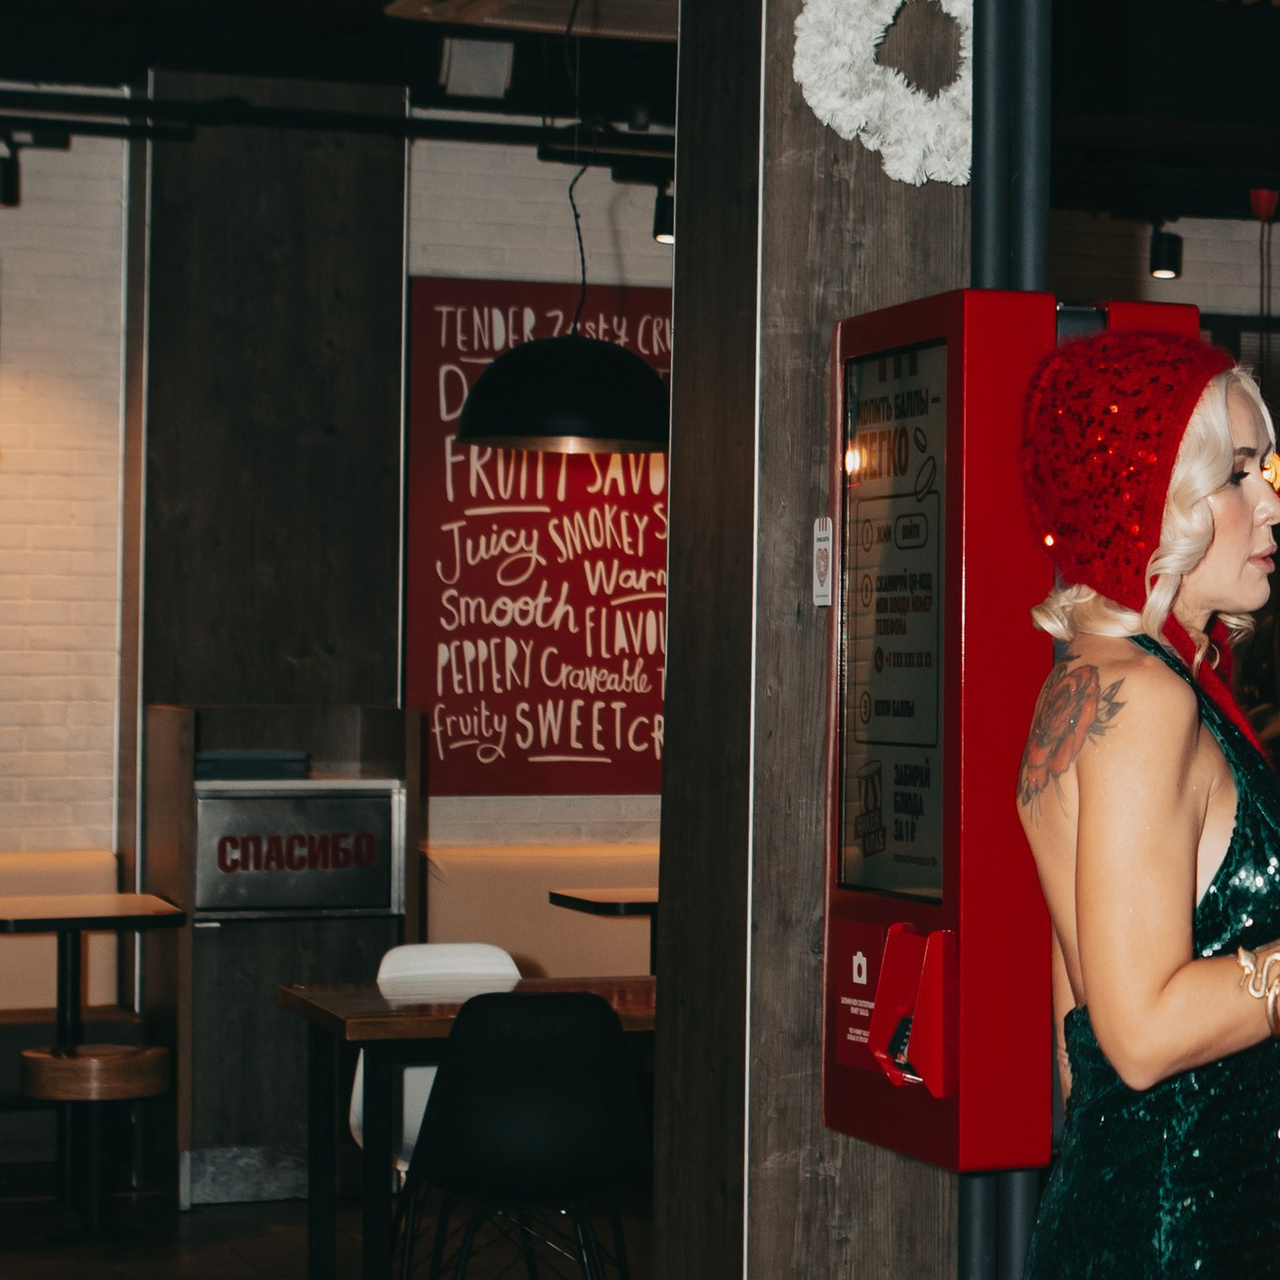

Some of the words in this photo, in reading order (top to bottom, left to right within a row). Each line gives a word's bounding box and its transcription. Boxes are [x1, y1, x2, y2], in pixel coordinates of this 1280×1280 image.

[433, 305, 536, 352] TENDER
[894, 388, 929, 421] БАЛЛЫ
[435, 520, 548, 586] Juicy
[548, 502, 649, 564] SMOKEY
[439, 579, 580, 634] Smooth
[436, 635, 534, 697] PEPPERY
[540, 645, 653, 695] Craveable
[430, 700, 507, 764] fruity
[515, 698, 628, 751] SWEET
[894, 757, 931, 789] ЗАБИРАЙ
[893, 791, 924, 821] БЛЮДА
[217, 831, 377, 874] СПАСИБО
